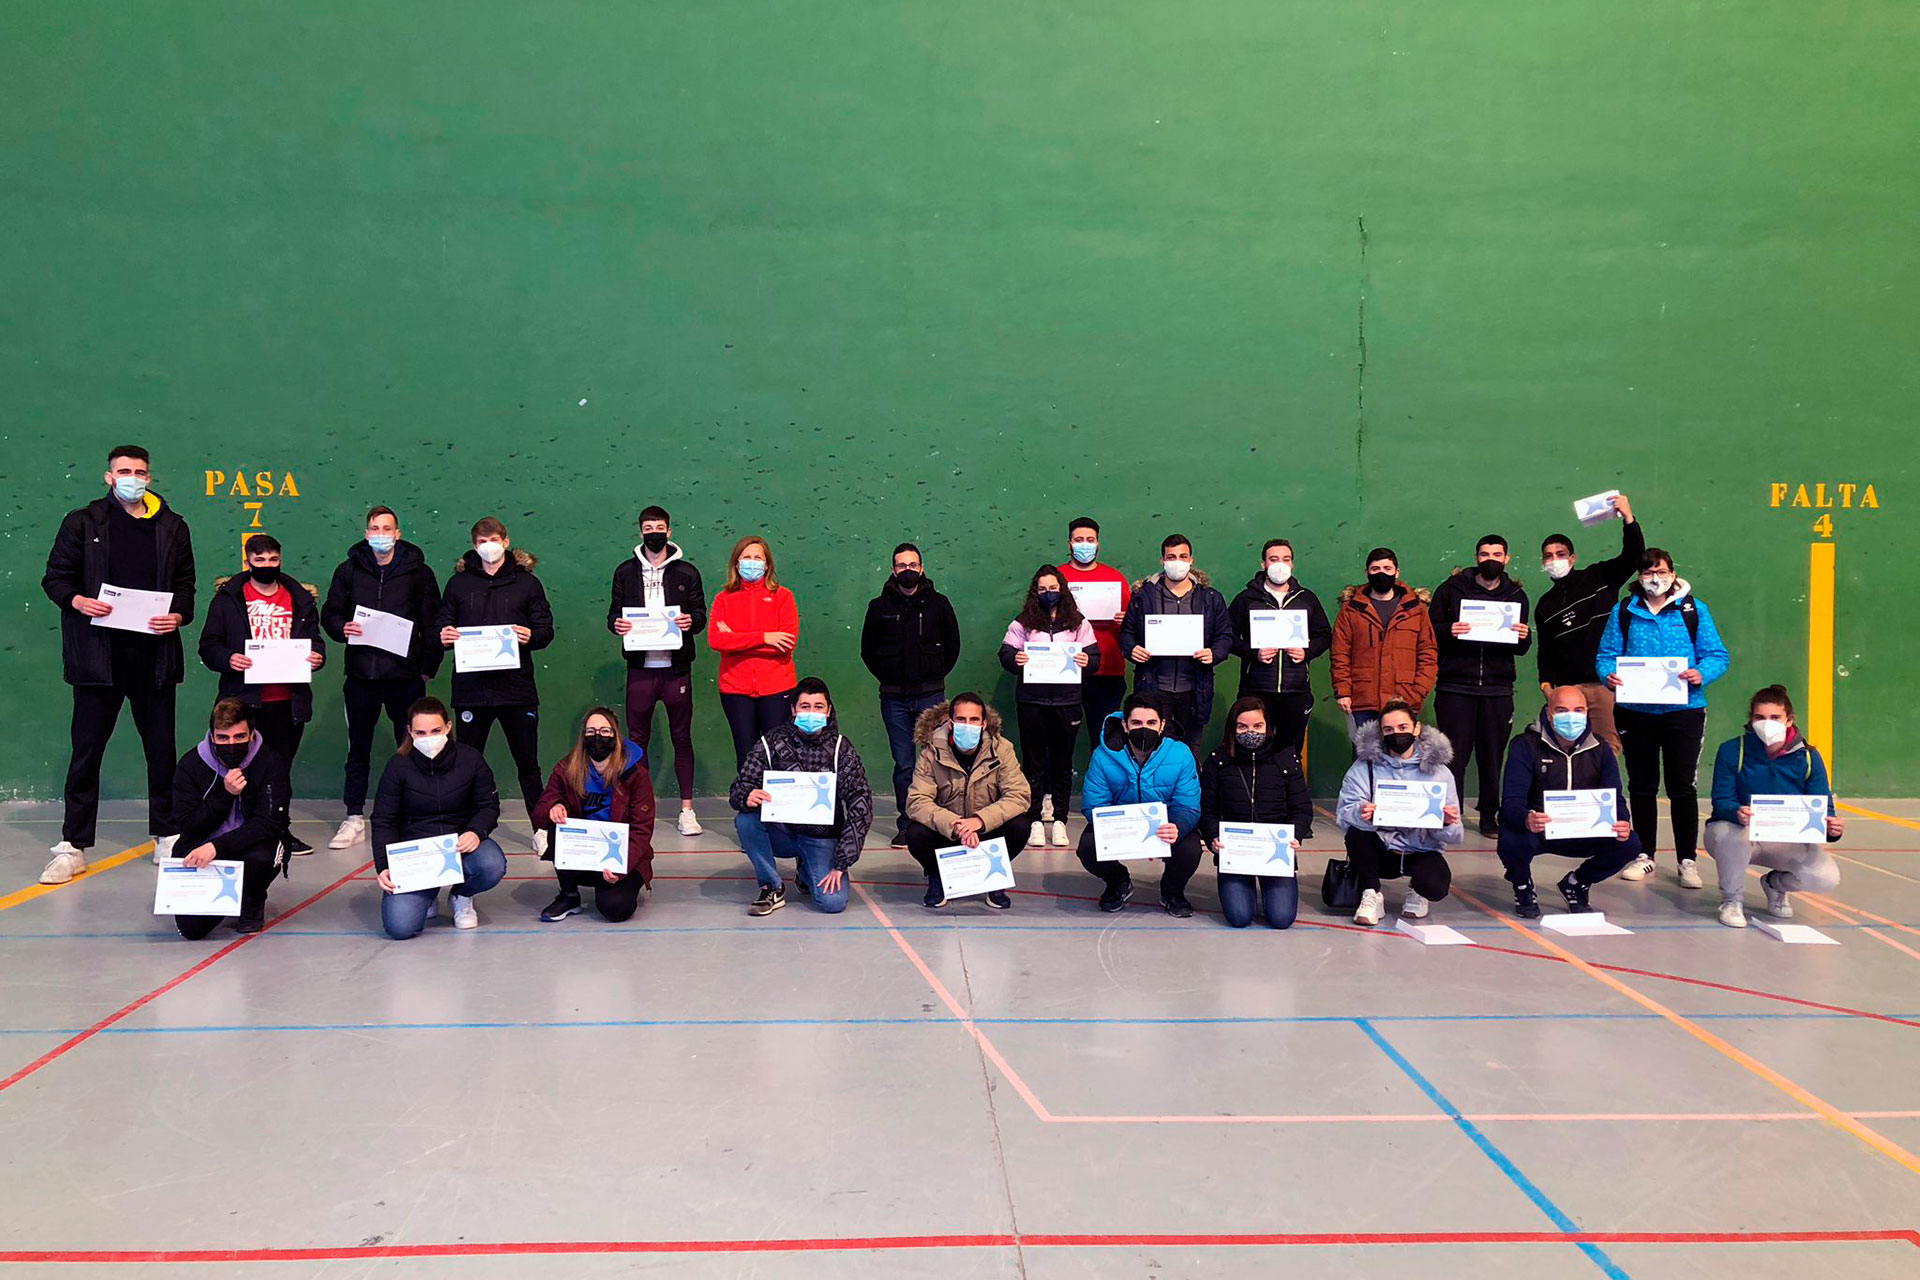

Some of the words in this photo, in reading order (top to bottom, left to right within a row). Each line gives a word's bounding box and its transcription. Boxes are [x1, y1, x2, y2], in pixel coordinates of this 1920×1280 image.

[205, 470, 300, 497] PASA
[1769, 482, 1880, 508] FALTA
[243, 502, 263, 528] 7
[1813, 513, 1833, 538] 4
